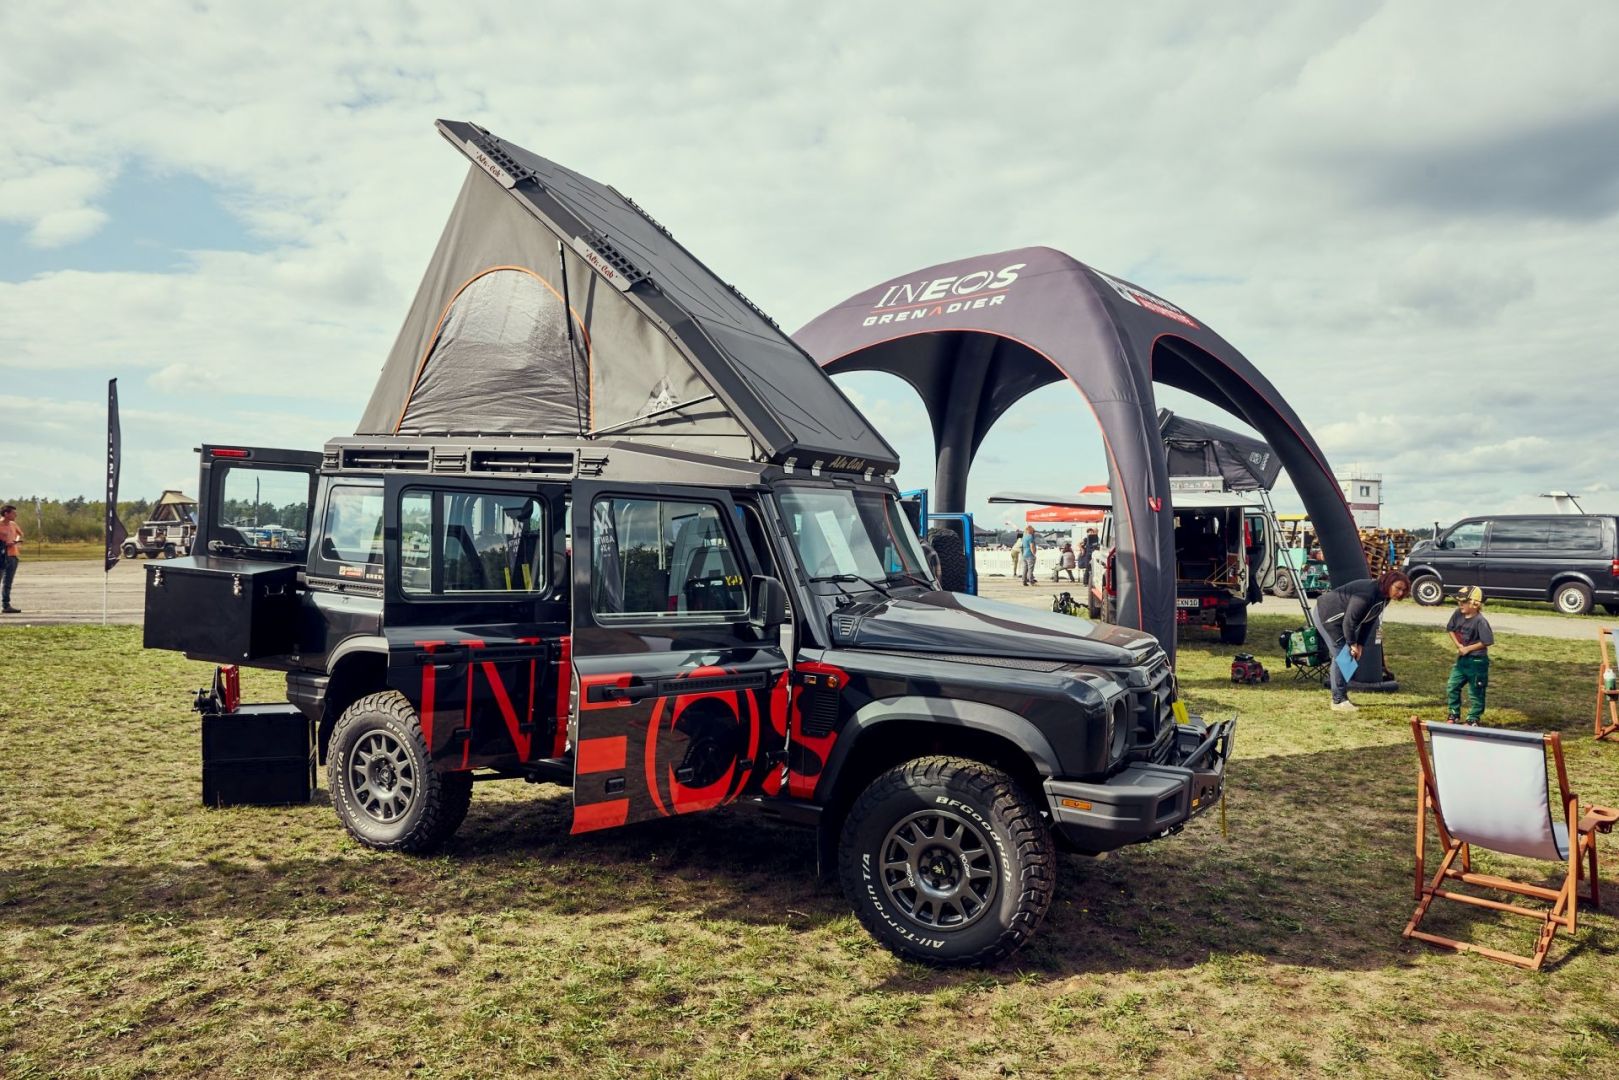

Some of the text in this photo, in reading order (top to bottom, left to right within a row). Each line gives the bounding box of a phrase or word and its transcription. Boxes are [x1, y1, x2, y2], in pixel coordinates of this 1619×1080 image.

[873, 263, 1027, 309] INEOS
[414, 635, 851, 836] INEOS
[935, 795, 1013, 882] BFGoodrich
[861, 852, 946, 949] All-Terrain T/A
